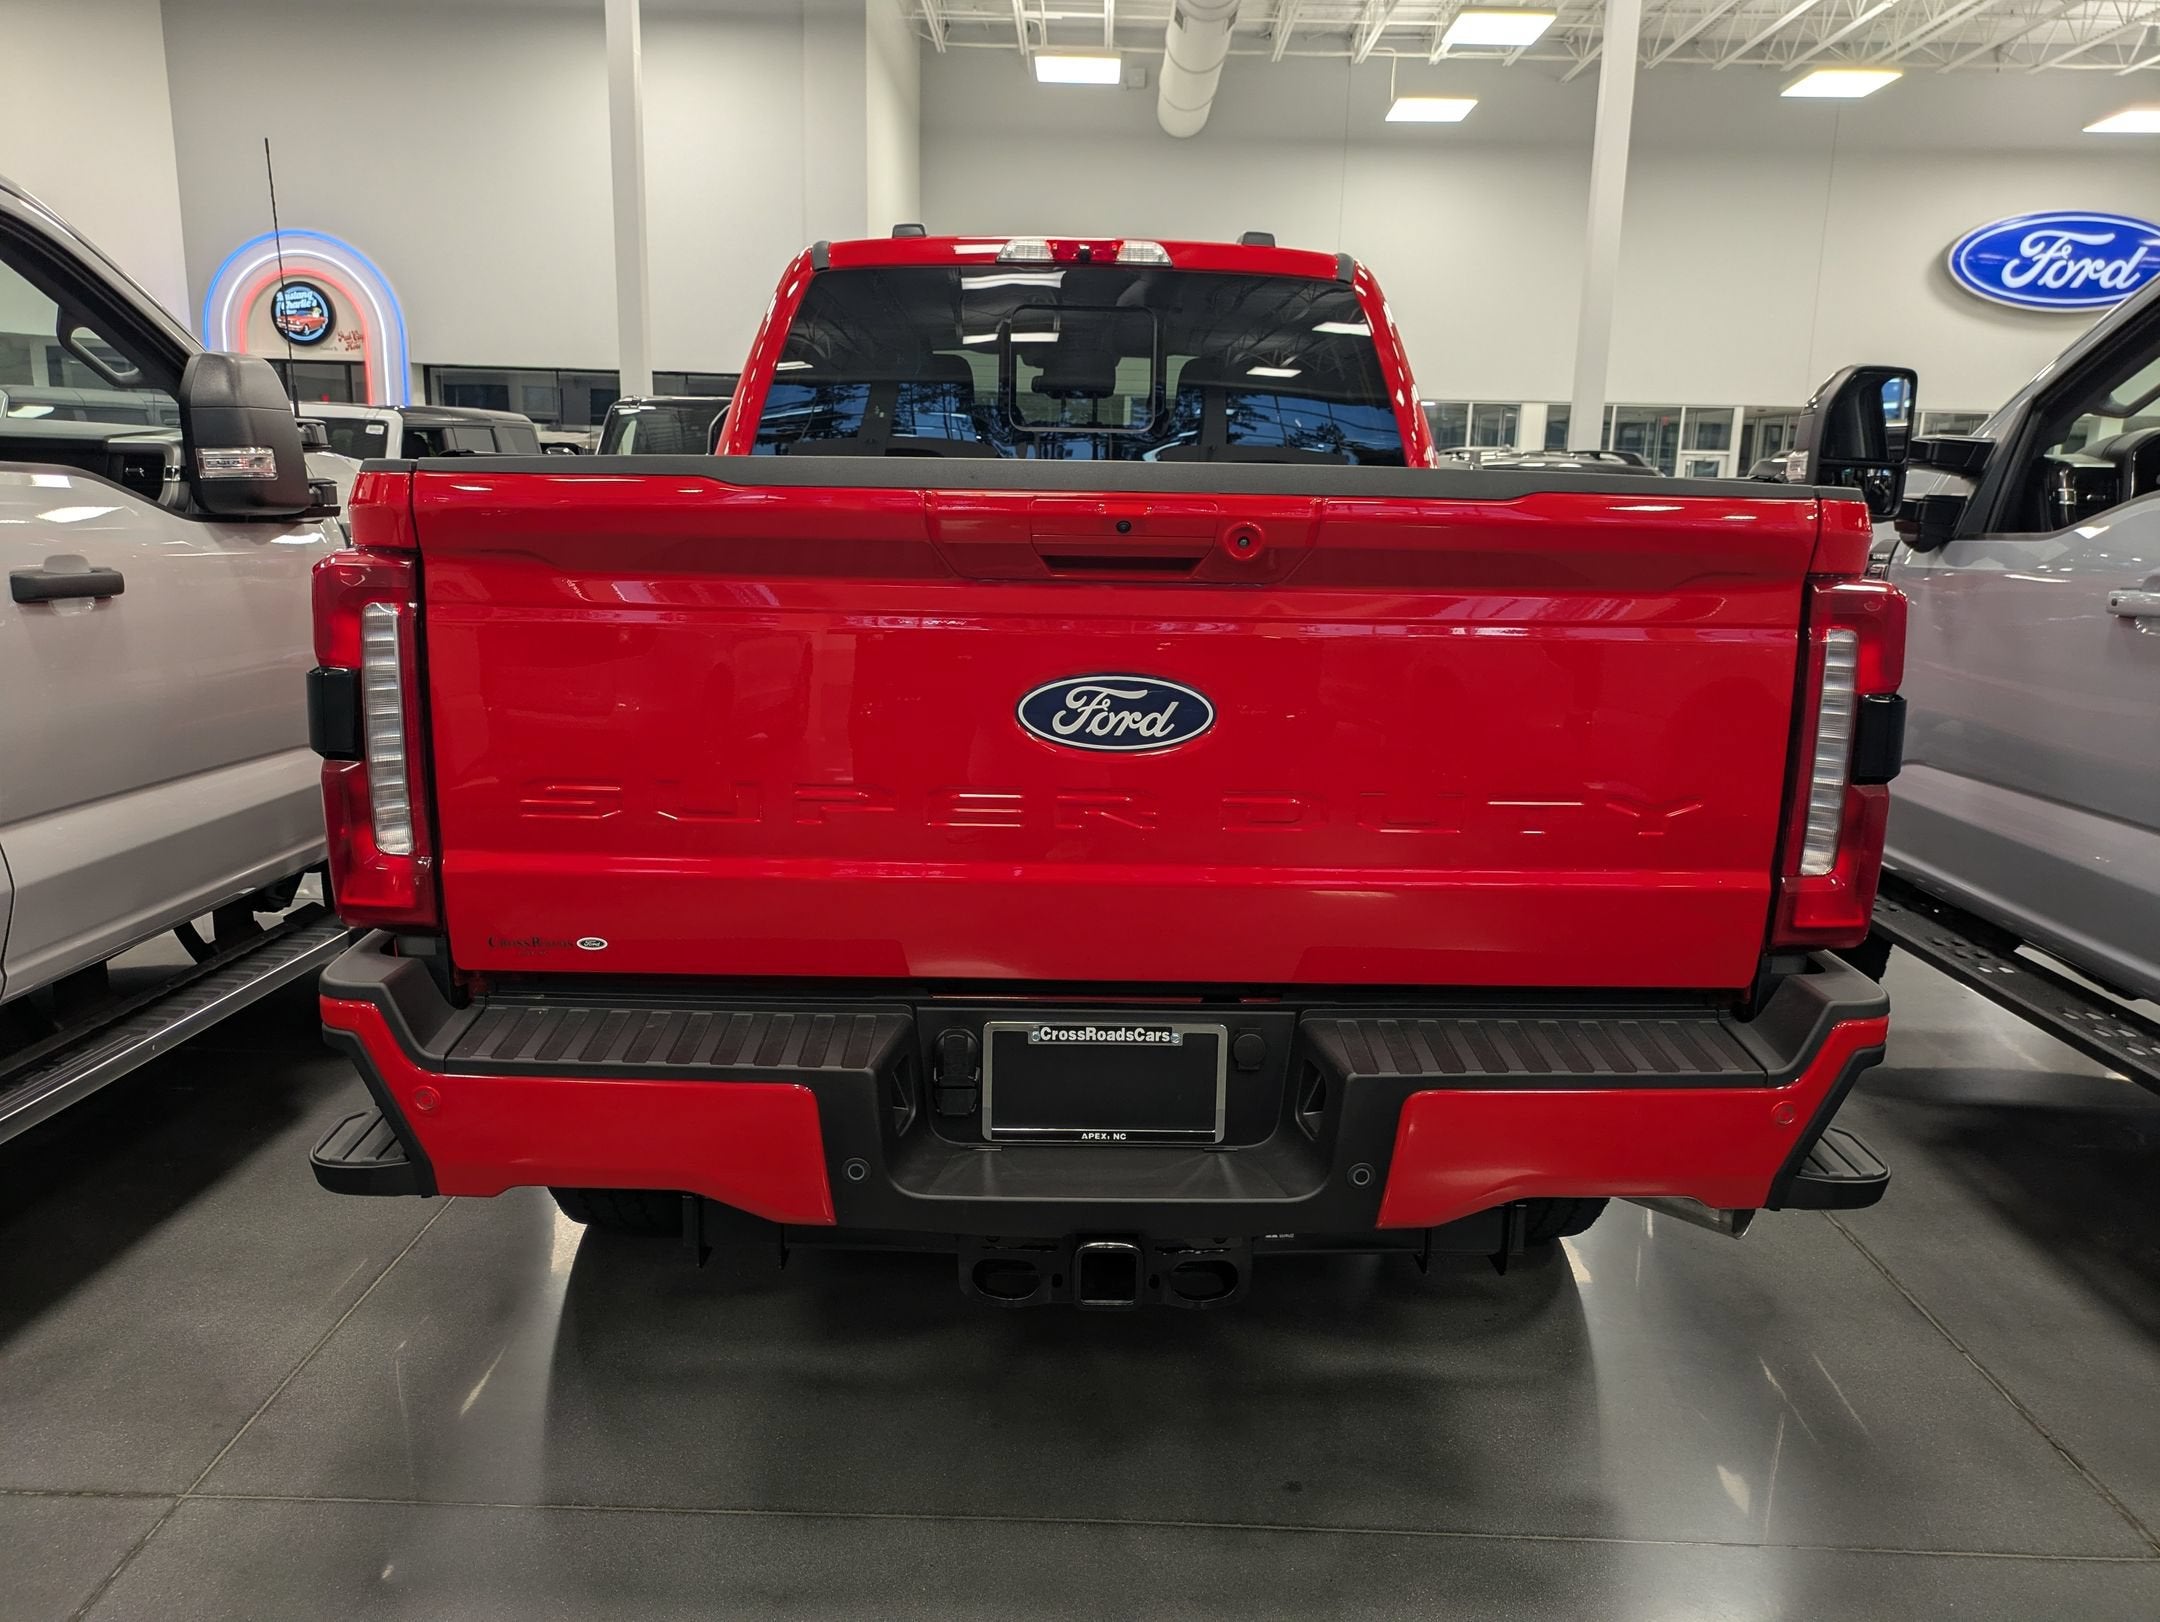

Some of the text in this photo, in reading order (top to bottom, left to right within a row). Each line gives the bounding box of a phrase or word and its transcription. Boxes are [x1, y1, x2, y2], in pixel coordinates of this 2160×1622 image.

[2001, 229, 2148, 290] Ford
[1052, 685, 1180, 738] Ford
[518, 777, 1706, 837] SUPER DUTY
[583, 939, 601, 947] Ford
[1040, 1026, 1170, 1042] CrossRoadsCars
[1081, 1132, 1127, 1141] APEX, NC
